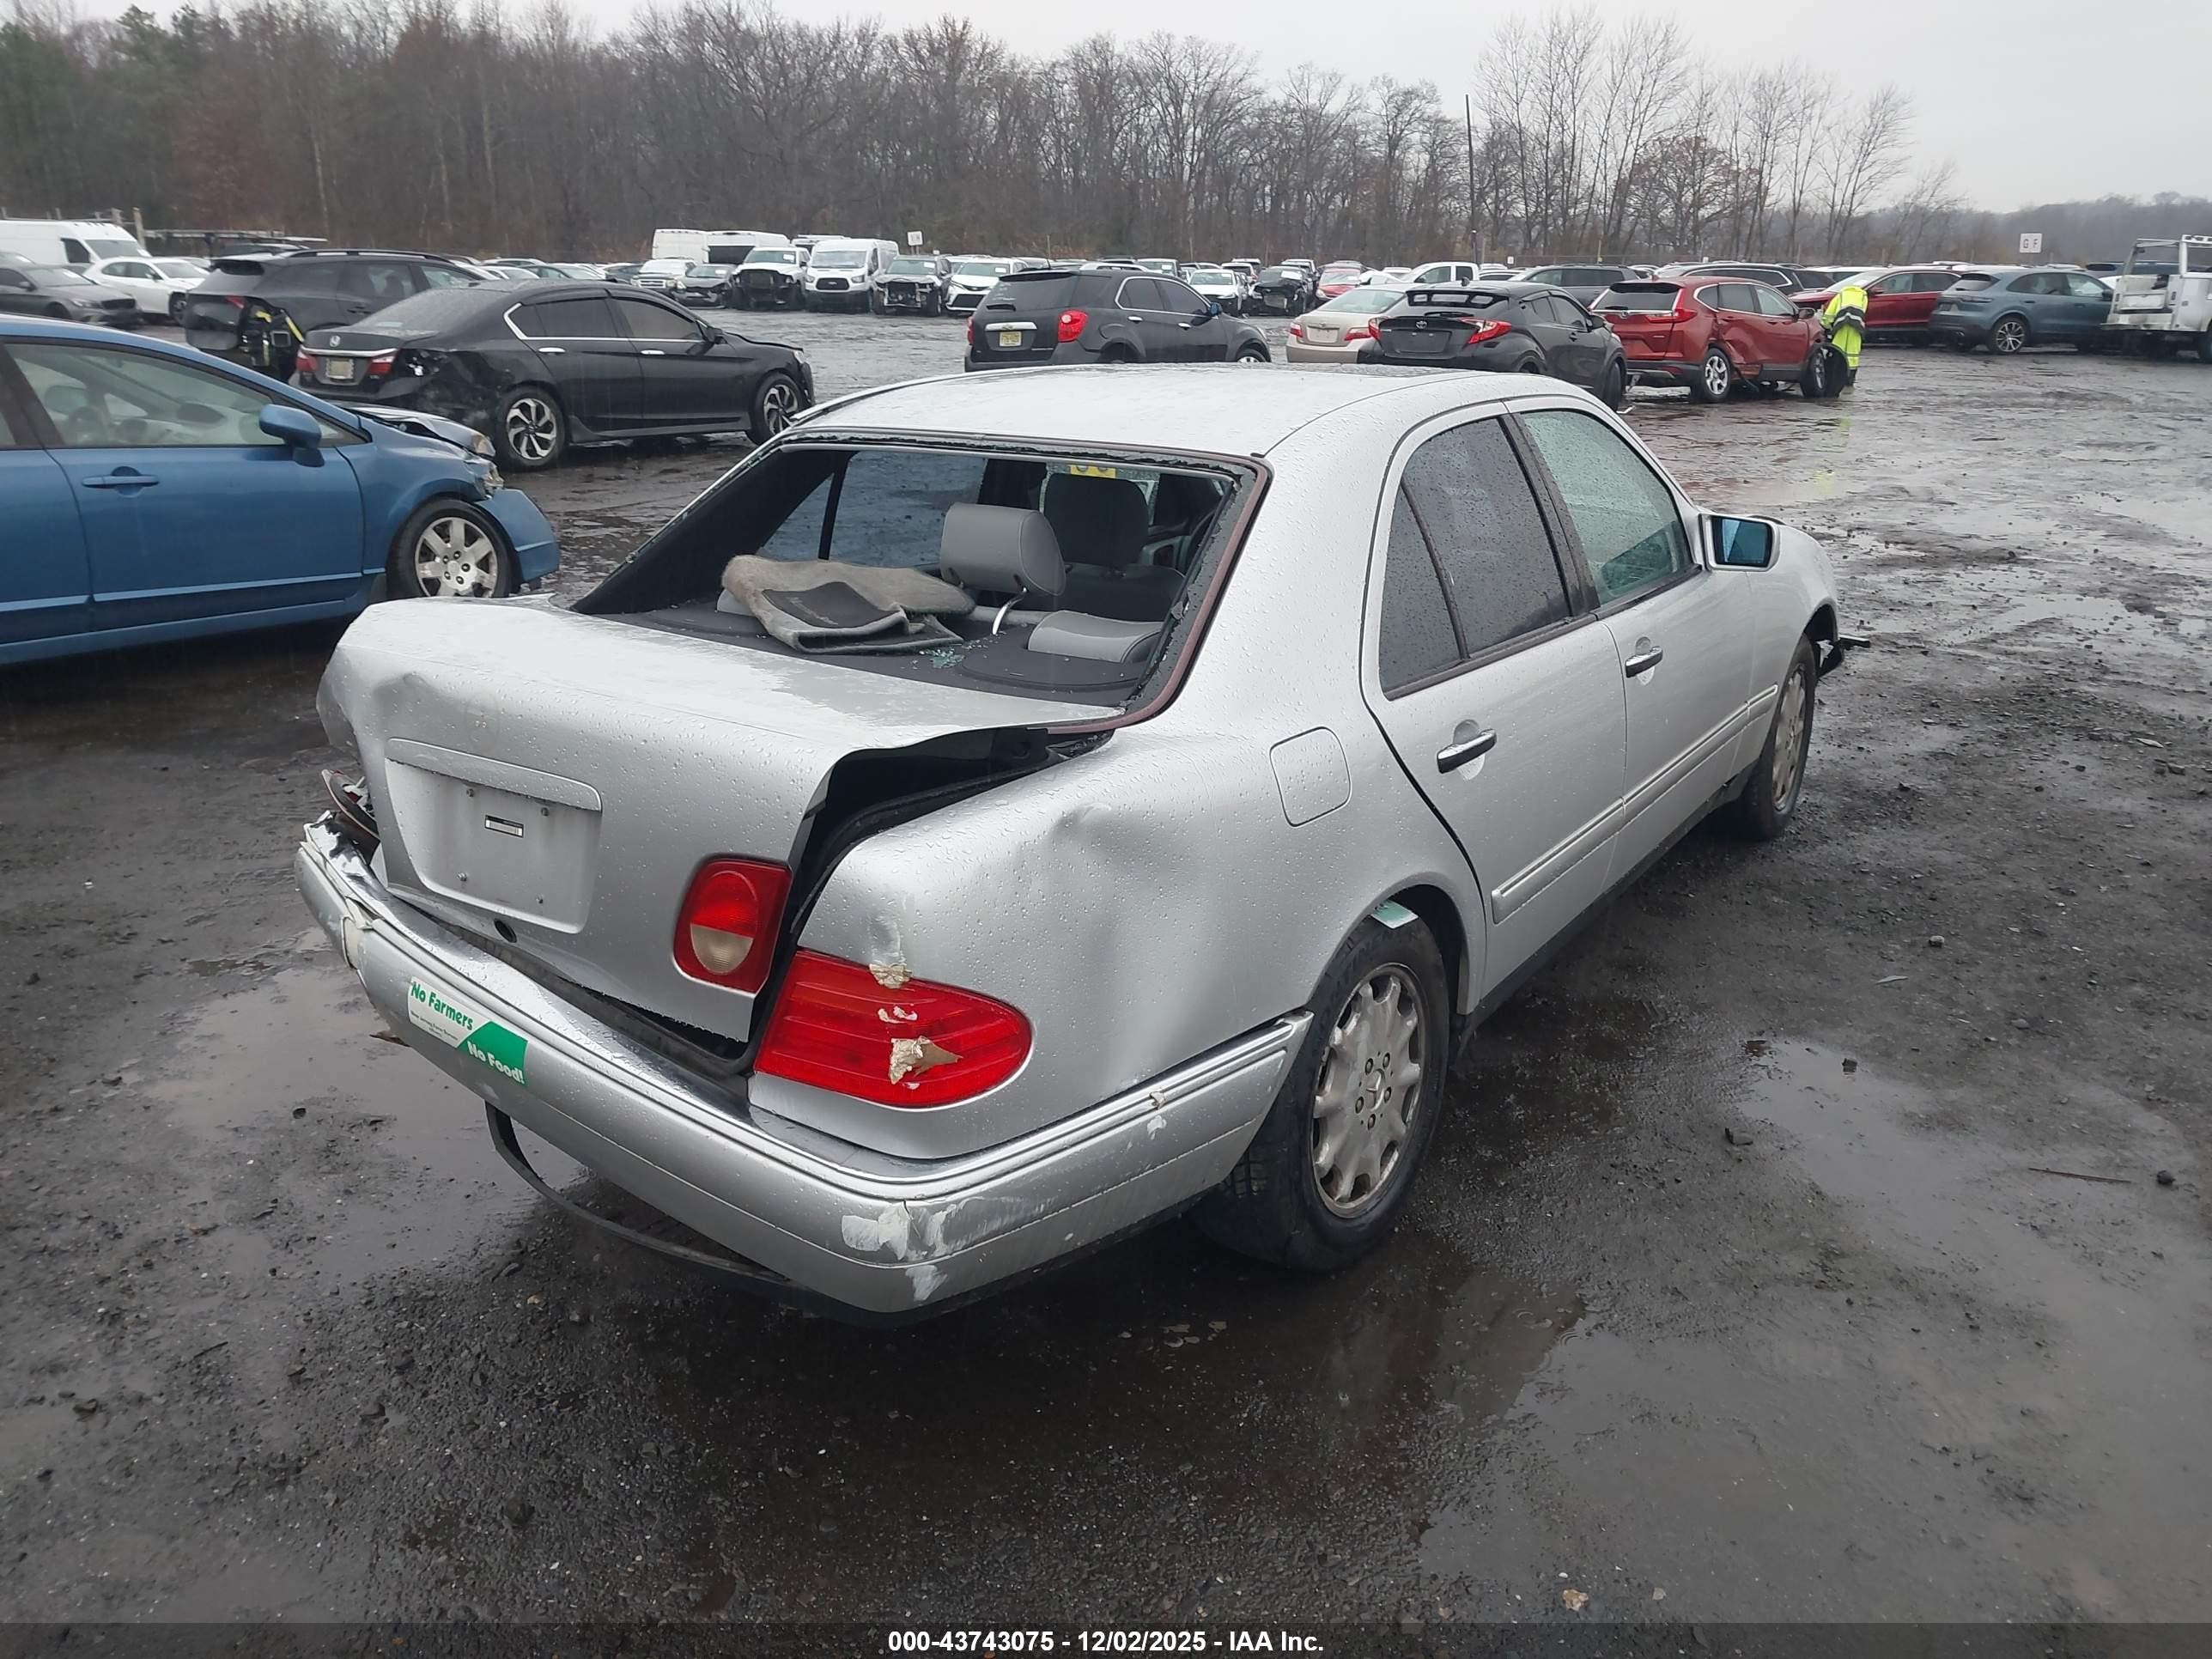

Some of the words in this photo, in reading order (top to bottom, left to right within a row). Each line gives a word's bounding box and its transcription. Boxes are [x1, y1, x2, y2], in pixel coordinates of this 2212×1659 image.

[410, 981, 426, 1002] No
[428, 991, 473, 1030] Farmers
[467, 1040, 486, 1062] No
[487, 1052, 525, 1085] Food!
